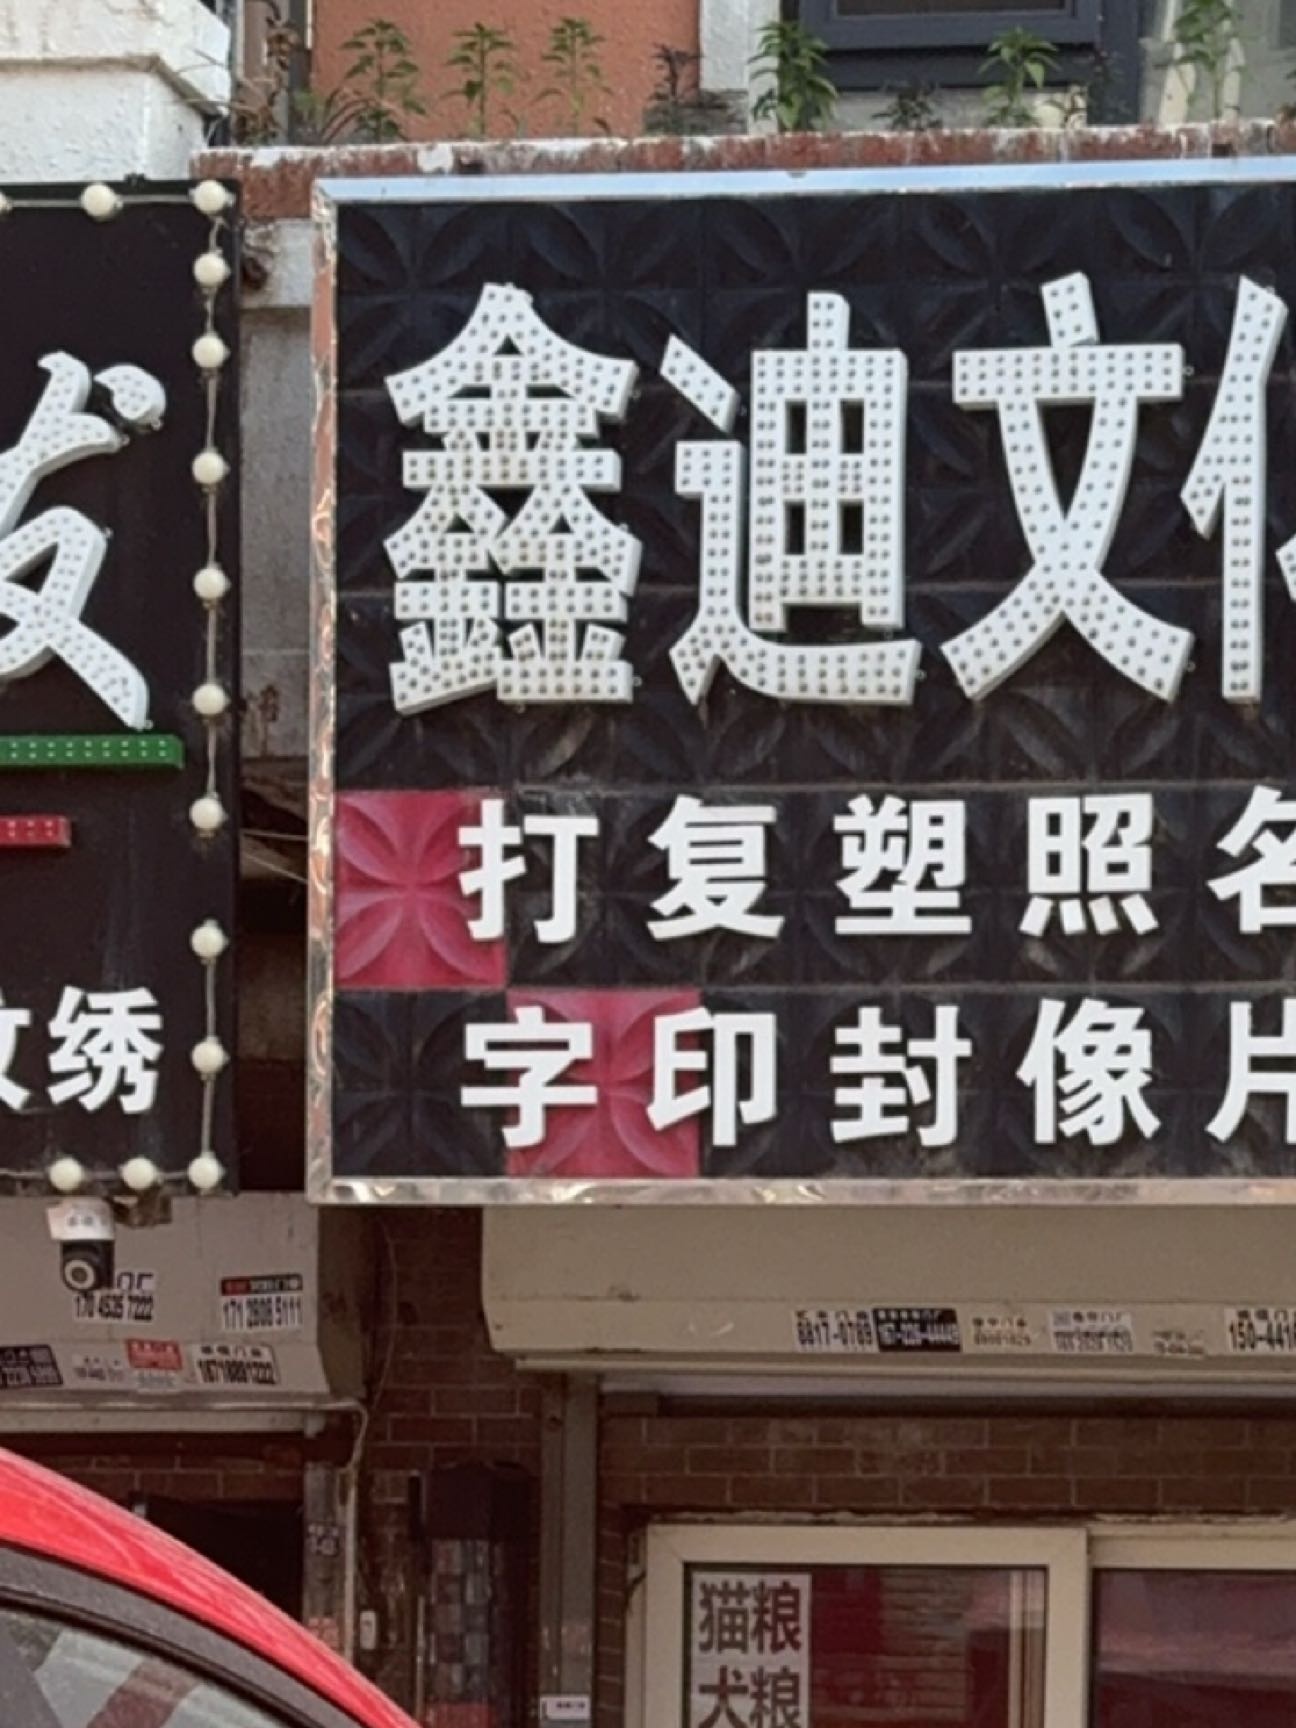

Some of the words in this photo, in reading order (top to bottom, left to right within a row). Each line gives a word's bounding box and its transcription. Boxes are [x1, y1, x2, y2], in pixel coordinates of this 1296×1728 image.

[0, 985, 164, 1115] 绣
[458, 797, 600, 1149] 打字
[646, 794, 785, 1147] 复印
[830, 794, 974, 1148] 塑封
[1015, 793, 1162, 1146] 照像
[698, 1580, 802, 1655] 猫粮
